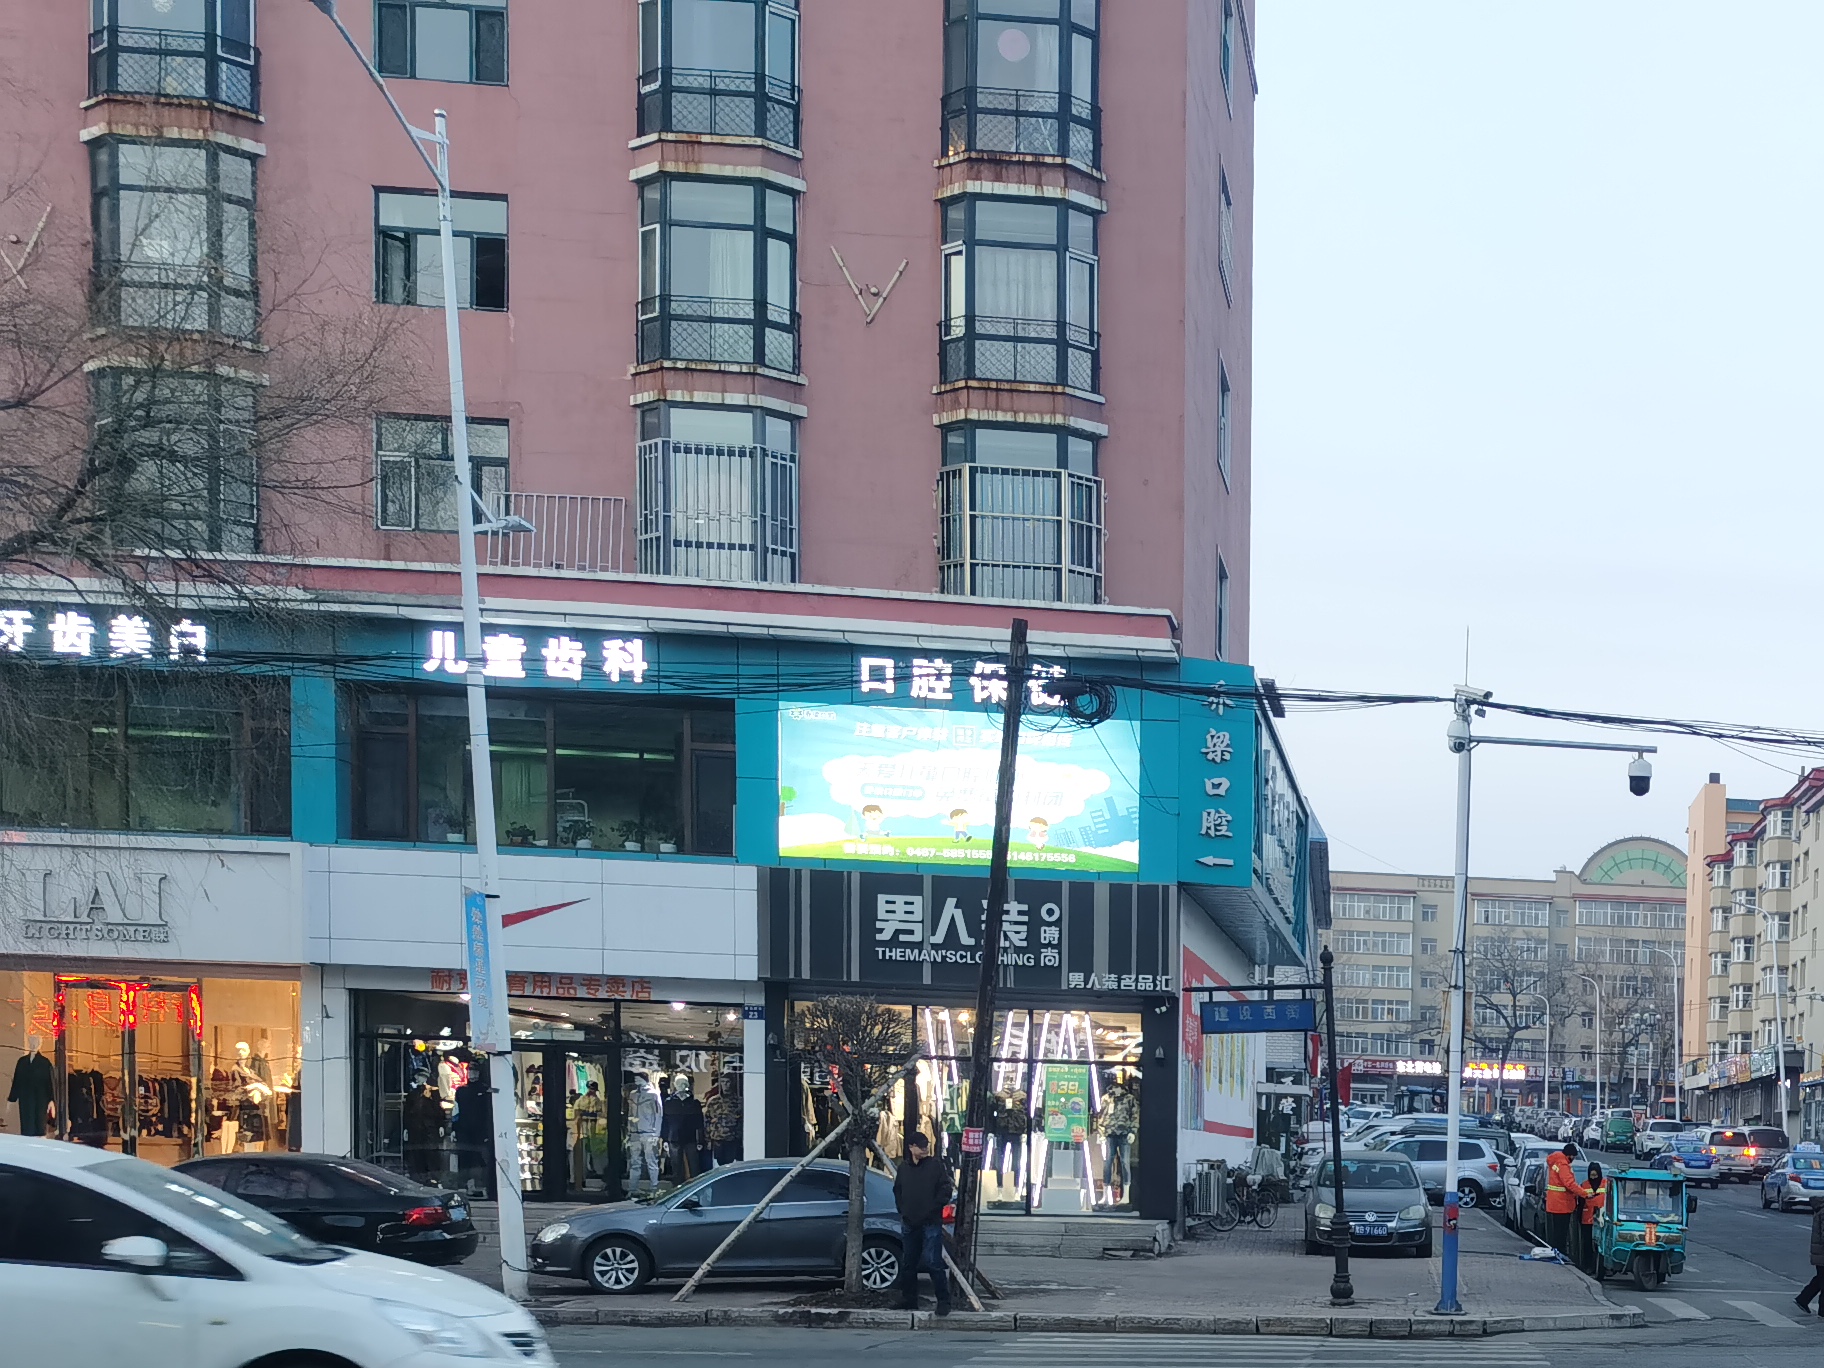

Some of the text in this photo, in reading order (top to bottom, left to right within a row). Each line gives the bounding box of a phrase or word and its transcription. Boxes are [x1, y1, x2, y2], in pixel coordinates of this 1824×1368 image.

[423, 629, 648, 684] 儿童齿科
[875, 893, 1029, 947] 男人装
[1040, 925, 1061, 967] 時尚
[1068, 972, 1174, 992] 男人装名品汇
[1213, 1004, 1301, 1022] 建设西街
